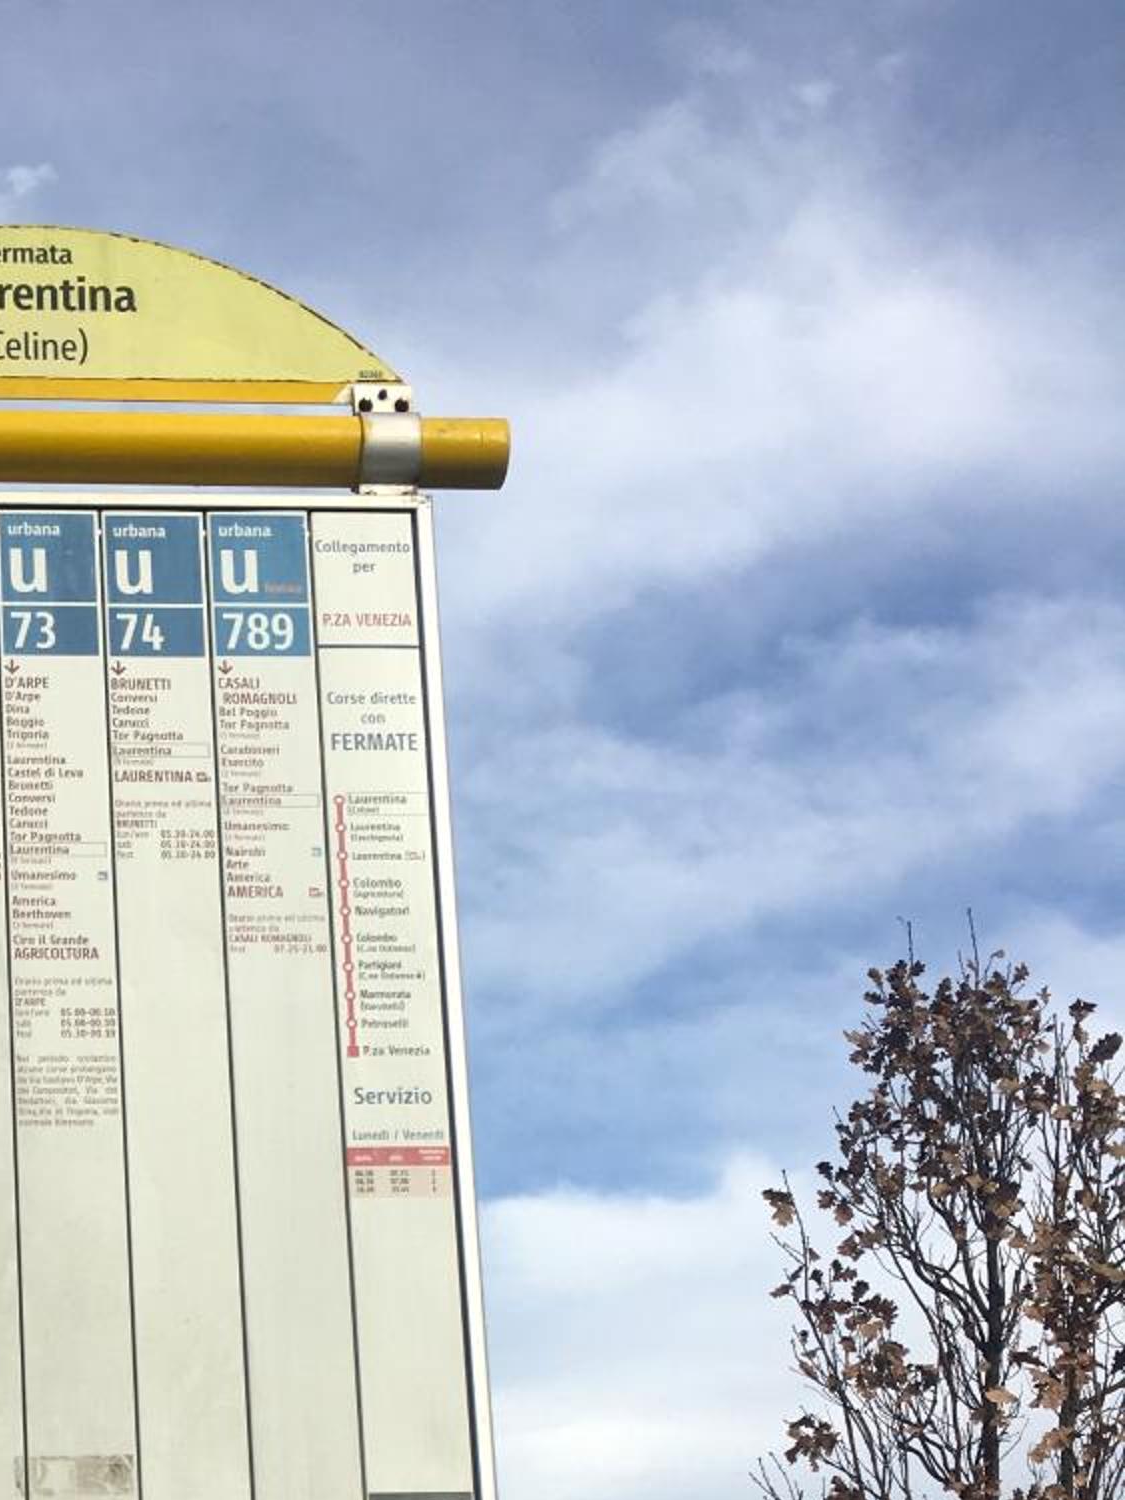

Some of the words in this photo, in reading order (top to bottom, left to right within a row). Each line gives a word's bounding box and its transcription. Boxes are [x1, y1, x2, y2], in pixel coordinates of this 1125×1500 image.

[8, 523, 59, 536] urbana
[113, 525, 166, 538] urbana
[219, 525, 271, 537] urbana
[315, 540, 410, 555] Collegamento
[9, 548, 47, 592] u
[115, 550, 153, 594] u
[220, 549, 259, 593] u
[353, 563, 376, 573] per
[323, 613, 351, 626] P.ZA
[356, 614, 411, 626] VENEZIA
[10, 611, 55, 649] 73
[116, 614, 165, 651] 74
[223, 613, 294, 649] 789
[5, 677, 49, 688] D'ARPE
[111, 678, 171, 690] BRUNETTI
[219, 678, 259, 688] CASALI
[5, 692, 40, 701] D'Arpe
[111, 693, 157, 702] Conversi
[223, 694, 296, 704] ROMAGNOLI
[328, 692, 365, 704] Corse
[371, 693, 416, 704] dirette
[112, 706, 150, 714] Tedone
[113, 719, 149, 727] Carucci
[361, 714, 385, 724] con
[220, 721, 235, 729] Tor
[241, 721, 289, 731] Pagnotta
[8, 731, 49, 740] Trigoria
[113, 732, 129, 740] Tor
[134, 732, 183, 742] Pagnotta
[331, 734, 417, 750] FERMATE
[114, 747, 171, 755] Laurentina
[8, 756, 65, 764] Laurentina
[8, 769, 41, 777] Castel
[45, 769, 55, 777] di
[115, 771, 192, 782] LAURENTINA
[9, 781, 52, 789] Brunetti
[223, 784, 239, 792] Tor
[244, 784, 293, 793] Pagnotta
[9, 794, 55, 802] Conversi
[223, 797, 281, 806] Laurentina
[349, 795, 407, 804] Laurentina
[10, 807, 47, 815] Tedone
[10, 820, 47, 828] Carucci
[10, 832, 25, 841] Tor
[31, 832, 81, 843] Pagnotta
[11, 846, 69, 855] Laurentina
[227, 861, 249, 869] Arte
[11, 872, 76, 880] Umanesimo
[227, 874, 270, 882] America
[353, 879, 401, 888] Colombo
[228, 886, 283, 898] AMERICA
[13, 897, 56, 906] America
[356, 907, 409, 916] Navigatori
[39, 935, 47, 944] il
[51, 935, 89, 945] Grande
[14, 948, 98, 960] AGRICOLTURA
[389, 1047, 430, 1055] Venezia
[354, 1088, 432, 1105] Servizio
